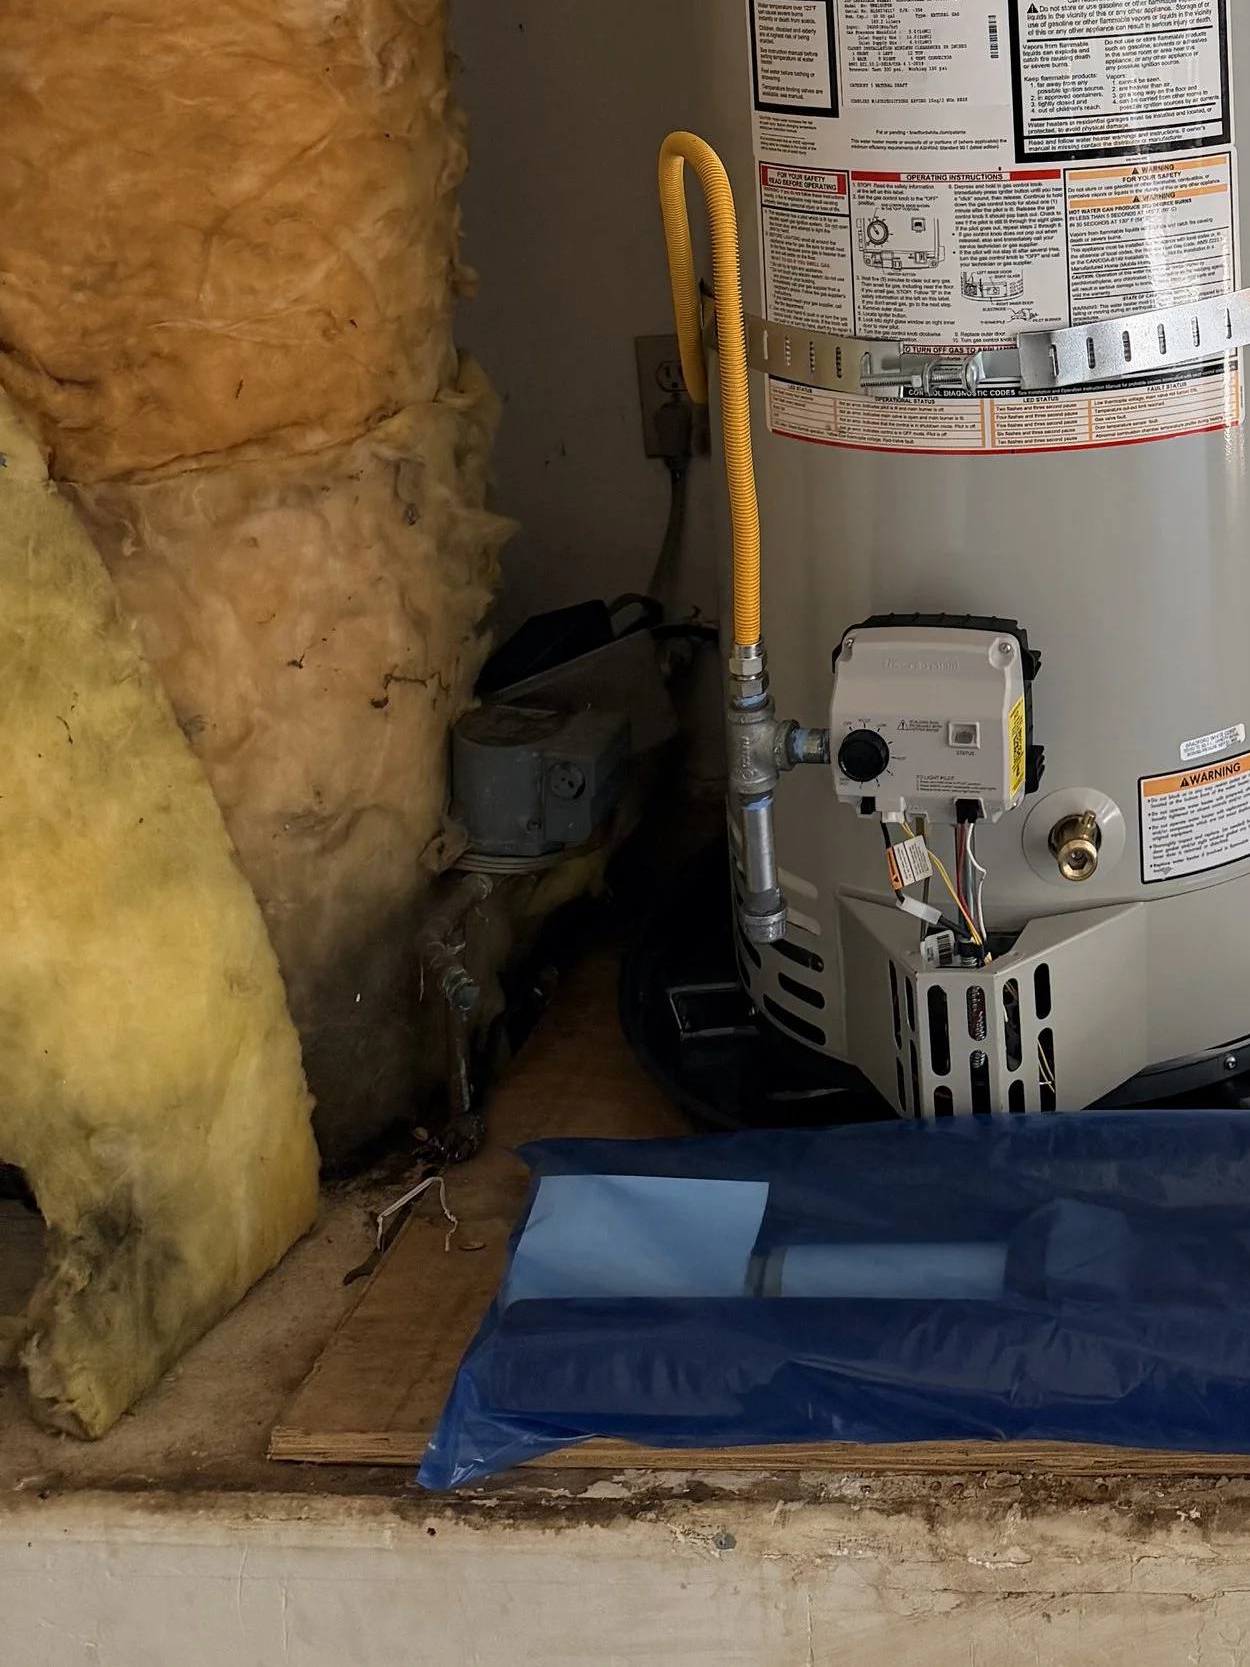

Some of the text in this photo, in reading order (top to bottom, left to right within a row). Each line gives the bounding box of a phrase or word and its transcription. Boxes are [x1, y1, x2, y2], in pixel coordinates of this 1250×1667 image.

[1098, 1, 1123, 11] gasoline
[1131, 0, 1147, 7] other
[1026, 13, 1047, 22] liquids
[1066, 11, 1088, 20] vicinity
[1127, 7, 1143, 15] other
[1144, 6, 1172, 15] appliance.
[1175, 3, 1197, 11] Storage
[1197, 1, 1203, 9] of
[1047, 20, 1074, 29] gasoline
[1099, 16, 1130, 24] flammable
[1131, 15, 1151, 23] vapors
[1159, 12, 1177, 21] liquids
[1194, 8, 1212, 16] vicinity
[1055, 27, 1067, 36] any
[1068, 26, 1084, 34] other
[1085, 25, 1114, 33] appliance
[1151, 20, 1172, 28] serious
[1173, 18, 1188, 27] injury
[1196, 16, 1212, 24] death.
[1141, 164, 1175, 174] WARNING
[803, 174, 826, 183] SAFETY
[906, 173, 1003, 182] OPERATING INSTRUCTIONS
[1138, 174, 1156, 182] YOUR
[1157, 171, 1182, 180] SAFETY
[768, 177, 837, 191] READ BEFORE OPERATING
[912, 346, 932, 354] TURN
[795, 385, 813, 394] STATUS
[1166, 382, 1188, 390] STATUS
[943, 389, 989, 397] DIAGNOSTIC
[990, 389, 1016, 397] CODES
[874, 396, 913, 405] OPERATIONAL
[1185, 736, 1210, 748] BRADFORD
[1210, 732, 1224, 742] WHITE
[1187, 762, 1241, 785] WARNING
